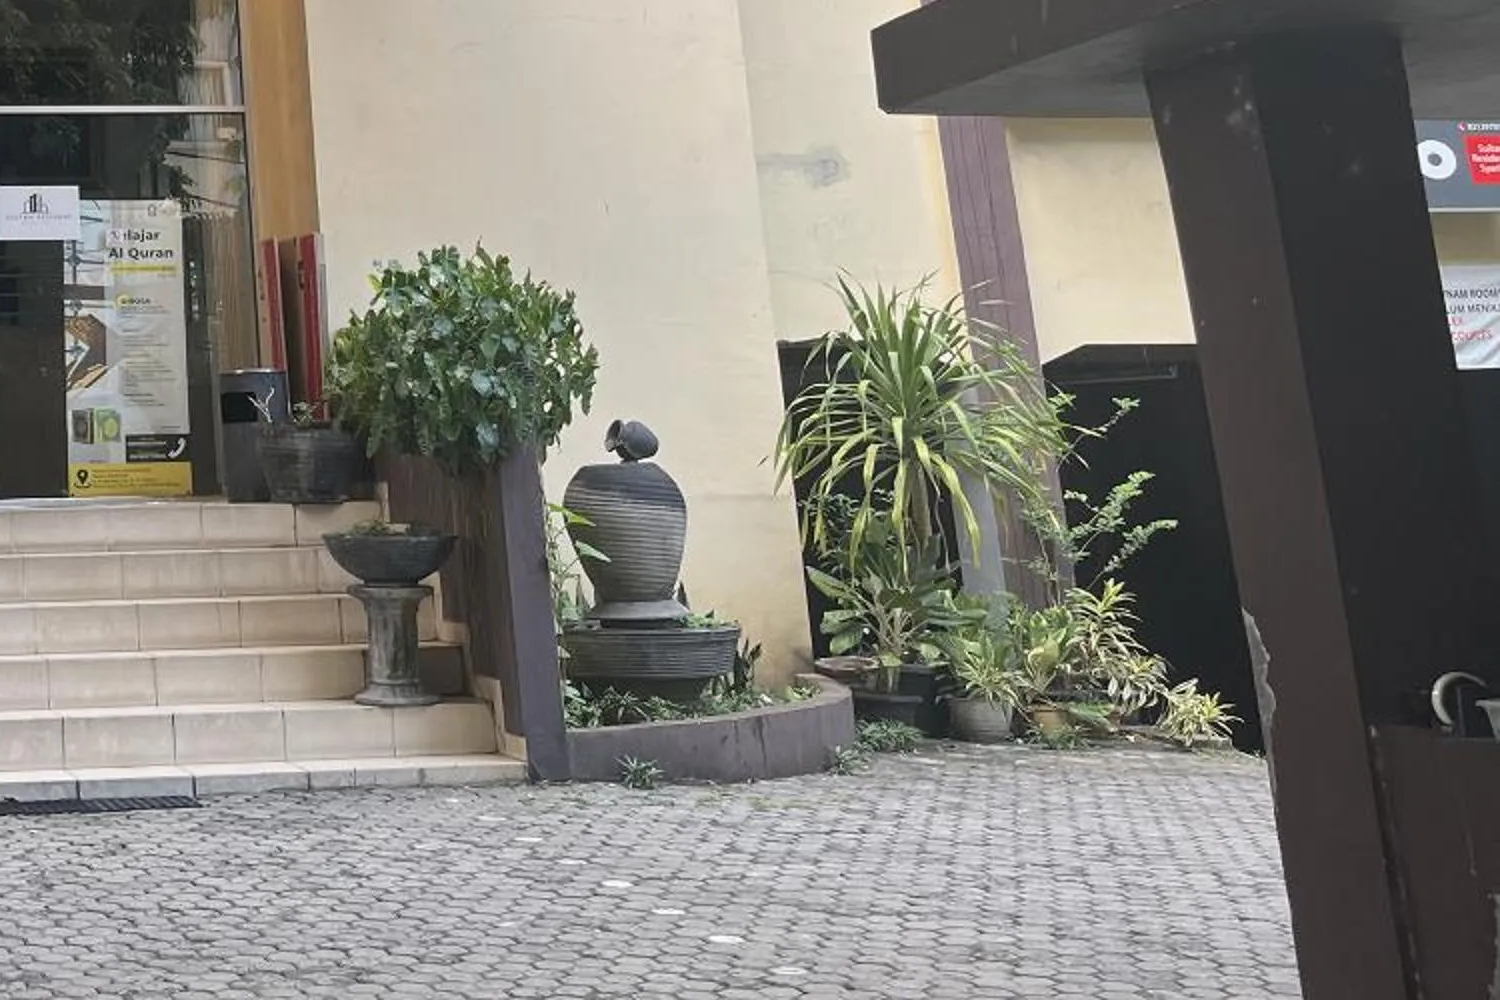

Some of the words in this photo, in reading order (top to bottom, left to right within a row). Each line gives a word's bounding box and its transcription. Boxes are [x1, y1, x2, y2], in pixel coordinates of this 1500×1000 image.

[110, 229, 160, 242] lajar
[108, 247, 123, 259] Al
[128, 247, 174, 260] Quran
